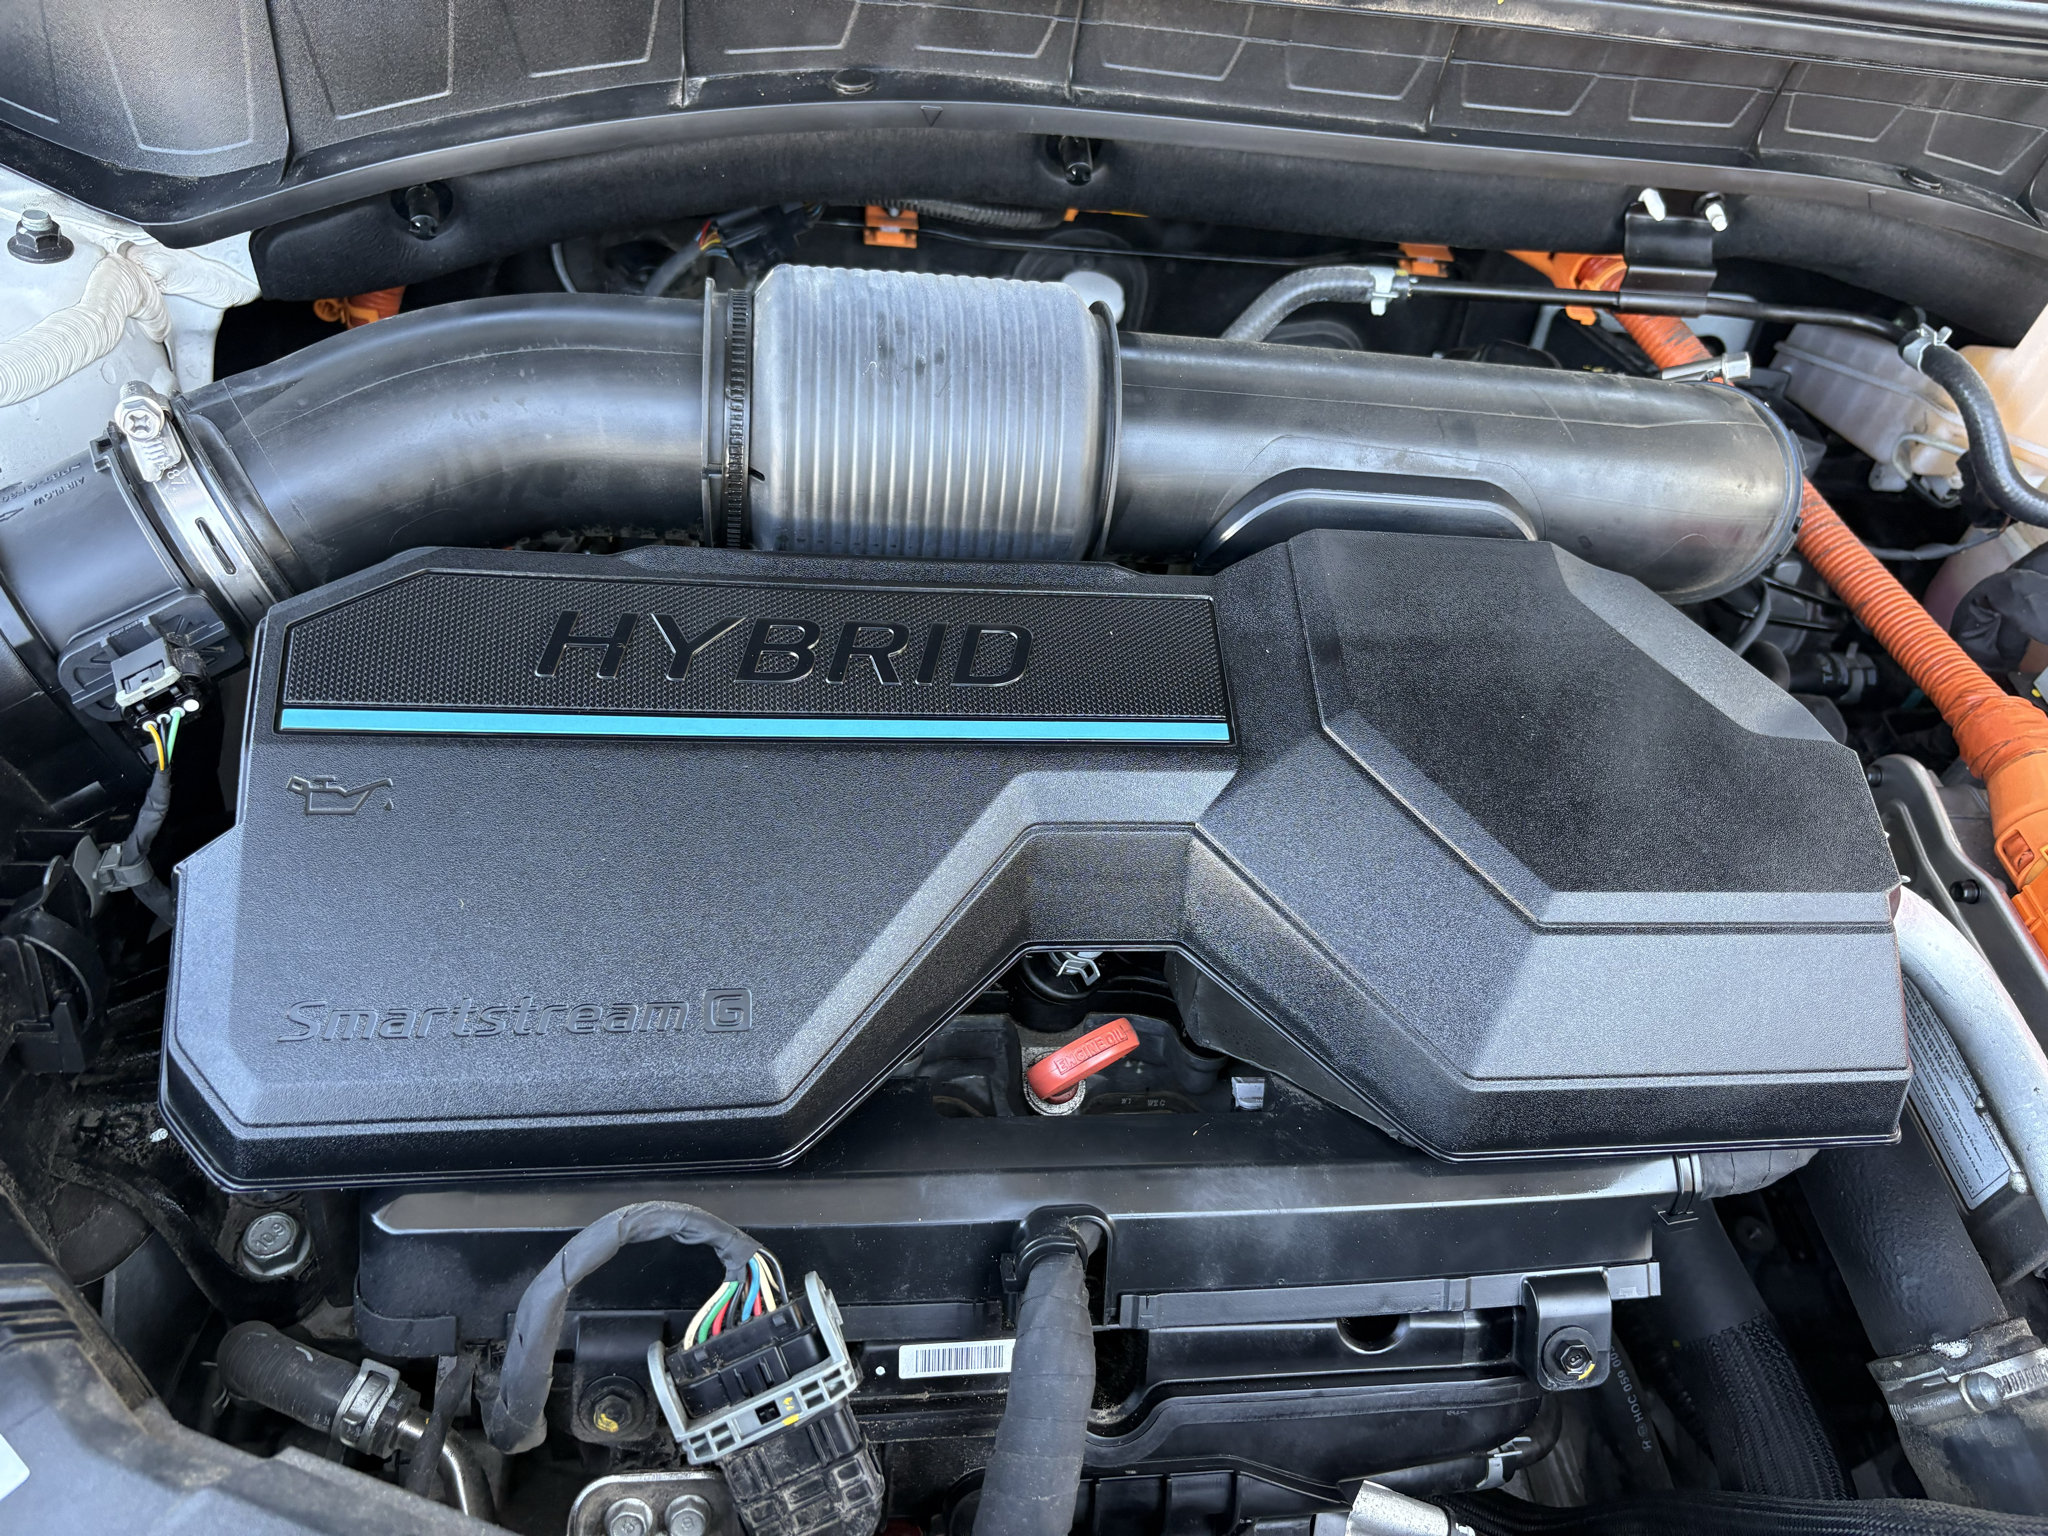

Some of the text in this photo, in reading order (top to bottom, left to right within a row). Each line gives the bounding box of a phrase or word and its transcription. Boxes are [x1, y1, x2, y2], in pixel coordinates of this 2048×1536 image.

[535, 609, 1035, 687] HYBRID
[278, 997, 690, 1042] Smartstream
[1056, 1027, 1128, 1072] ENGINE OIL
[1627, 1394, 1644, 1423] HOC
